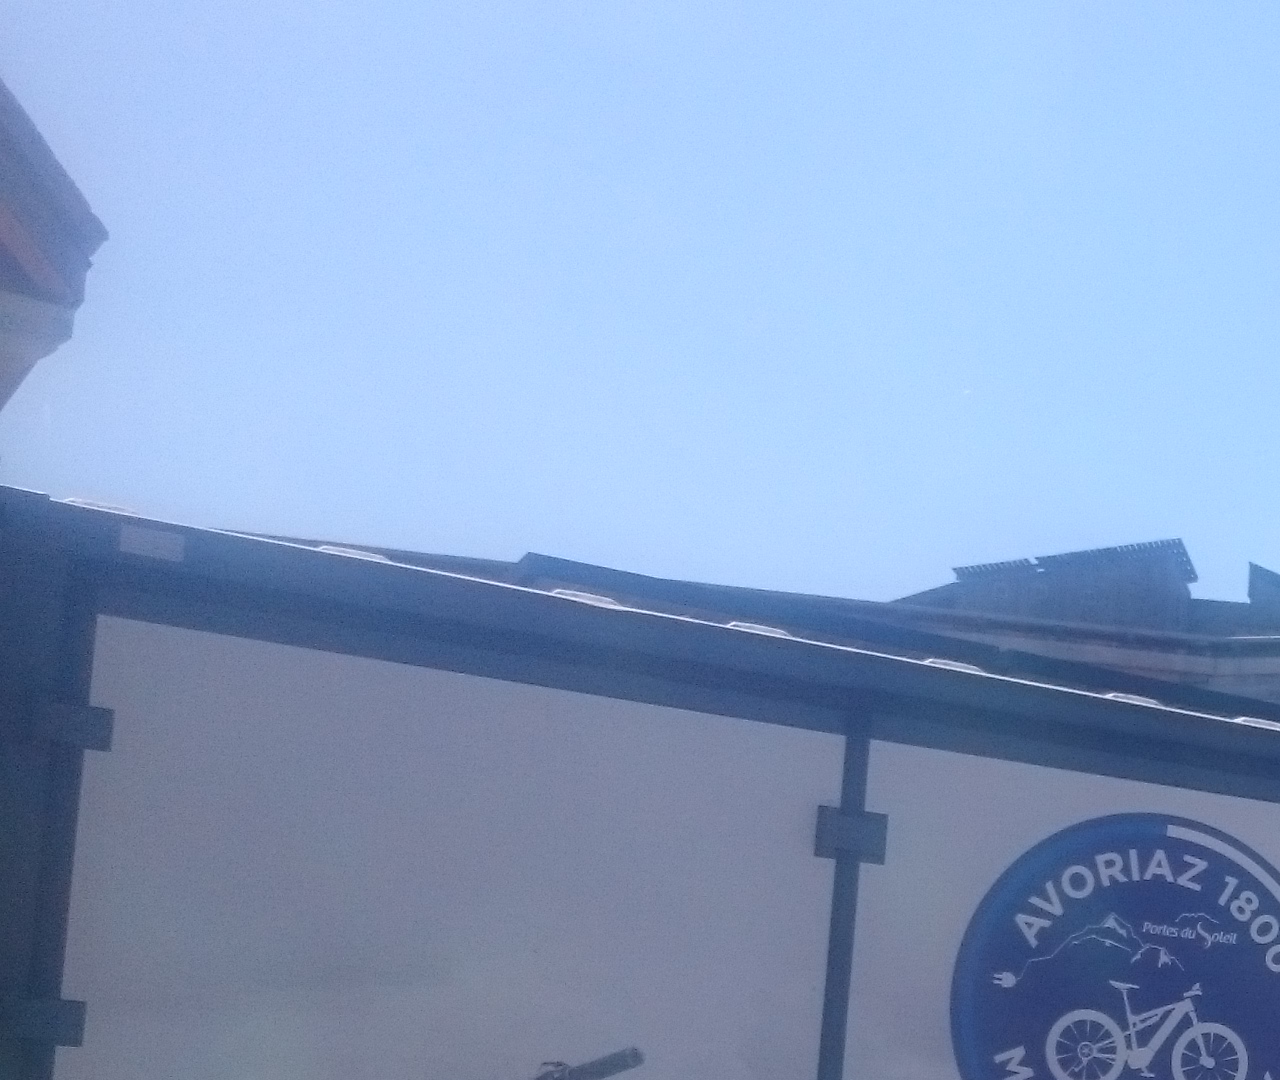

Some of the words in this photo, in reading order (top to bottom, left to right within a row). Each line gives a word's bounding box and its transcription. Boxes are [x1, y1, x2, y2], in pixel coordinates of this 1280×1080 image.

[1014, 848, 1208, 949] AVORIAZ
[1142, 921, 1178, 938] Portes
[1181, 927, 1197, 940] du
[1197, 921, 1237, 949] Soleil
